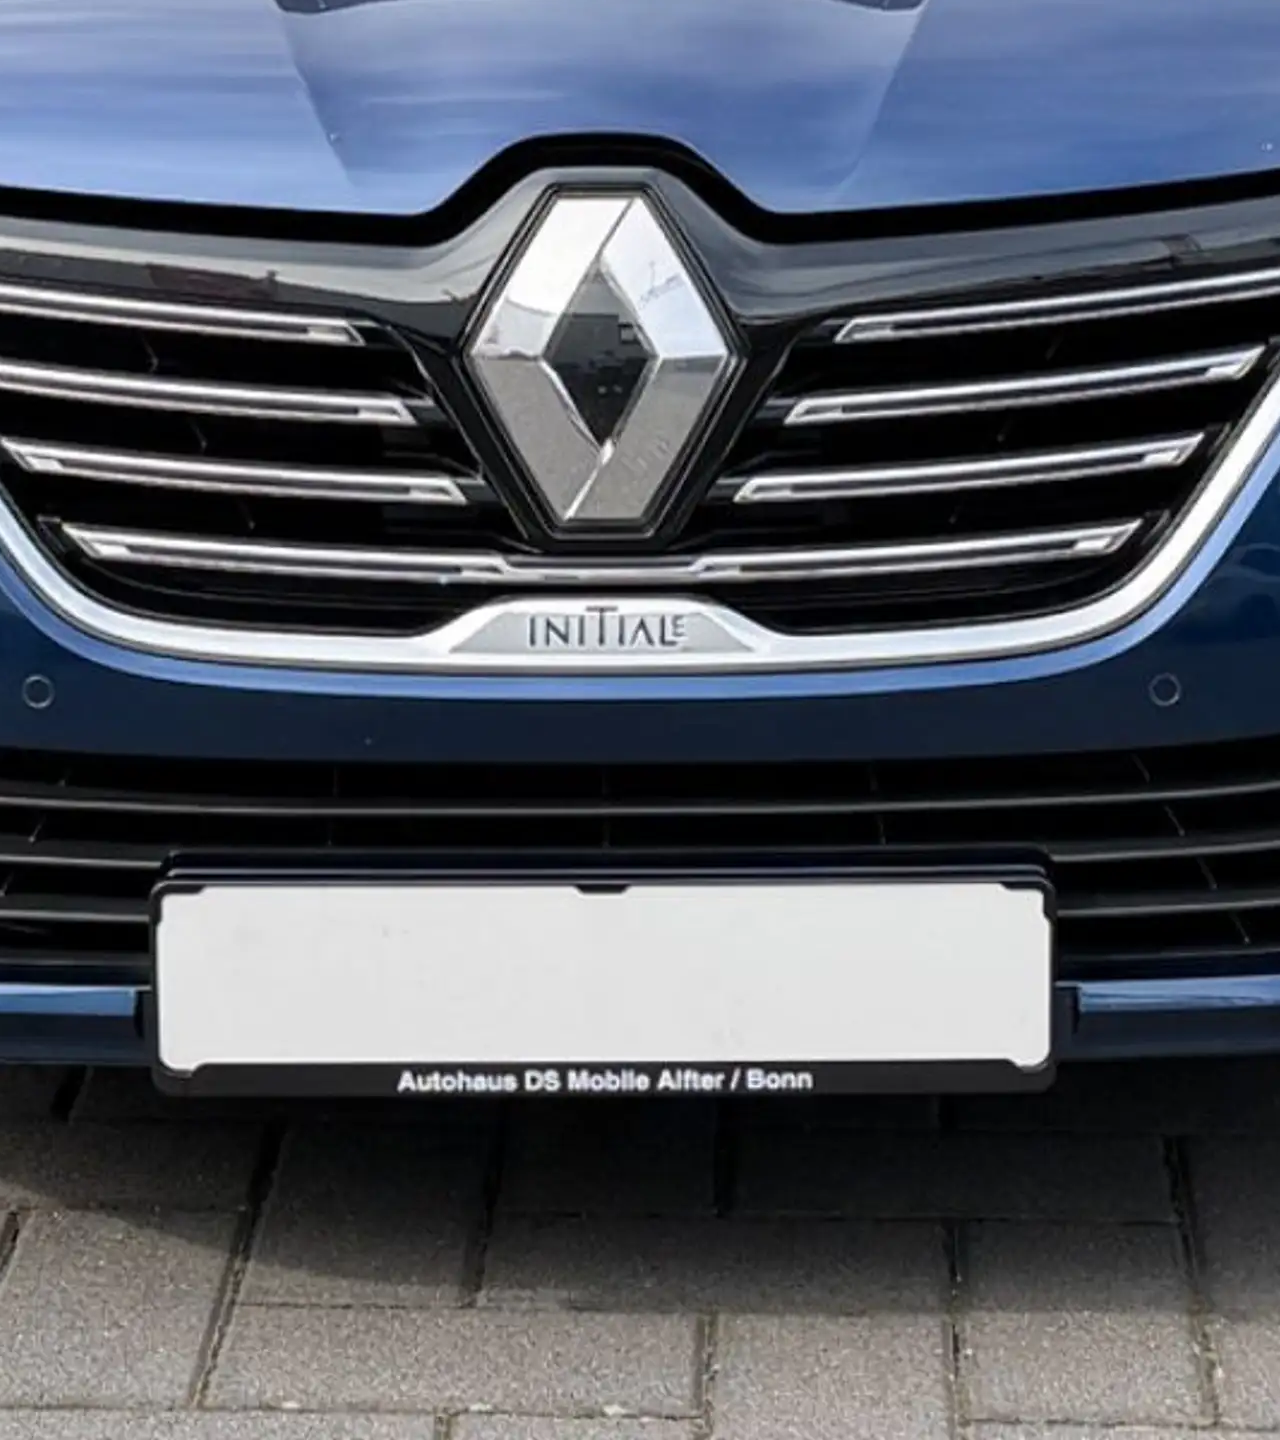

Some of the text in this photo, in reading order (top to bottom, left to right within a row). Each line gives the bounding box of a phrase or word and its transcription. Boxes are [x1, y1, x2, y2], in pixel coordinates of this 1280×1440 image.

[529, 606, 685, 647] INITIALE
[397, 1068, 813, 1092] Autohaus DS Mobile Alfter / Bonn
